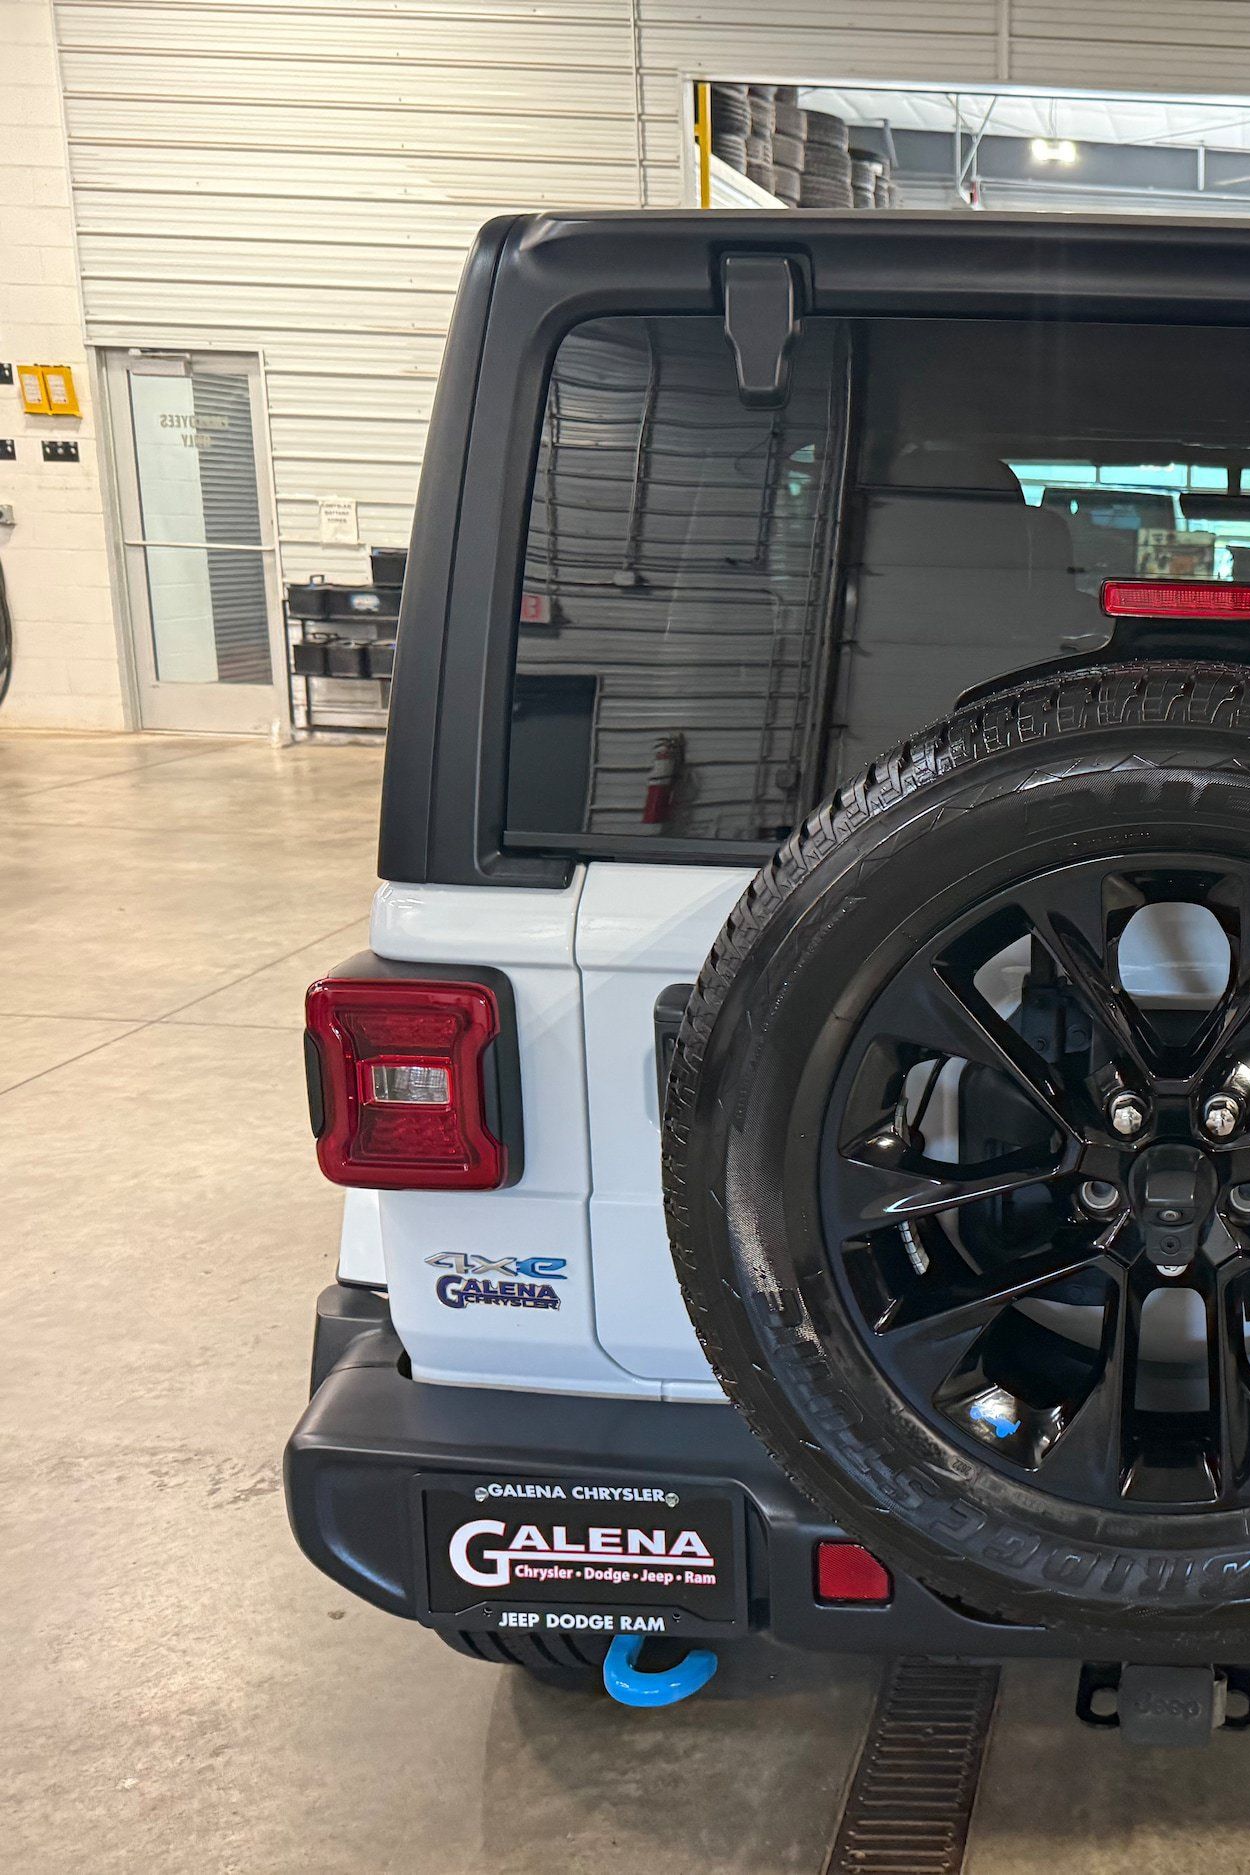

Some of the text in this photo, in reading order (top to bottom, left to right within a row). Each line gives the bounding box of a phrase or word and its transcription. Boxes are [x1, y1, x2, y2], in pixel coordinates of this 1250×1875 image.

[436, 1274, 559, 1309] GALENA
[464, 1295, 561, 1311] CHRYSLER
[488, 1483, 665, 1503] GALENA CHRYSLER
[449, 1519, 714, 1588] GALENA
[515, 1565, 717, 1586] Chrysler Dodge Jeep Ram
[499, 1612, 666, 1633] JEEP DODGE RAM
